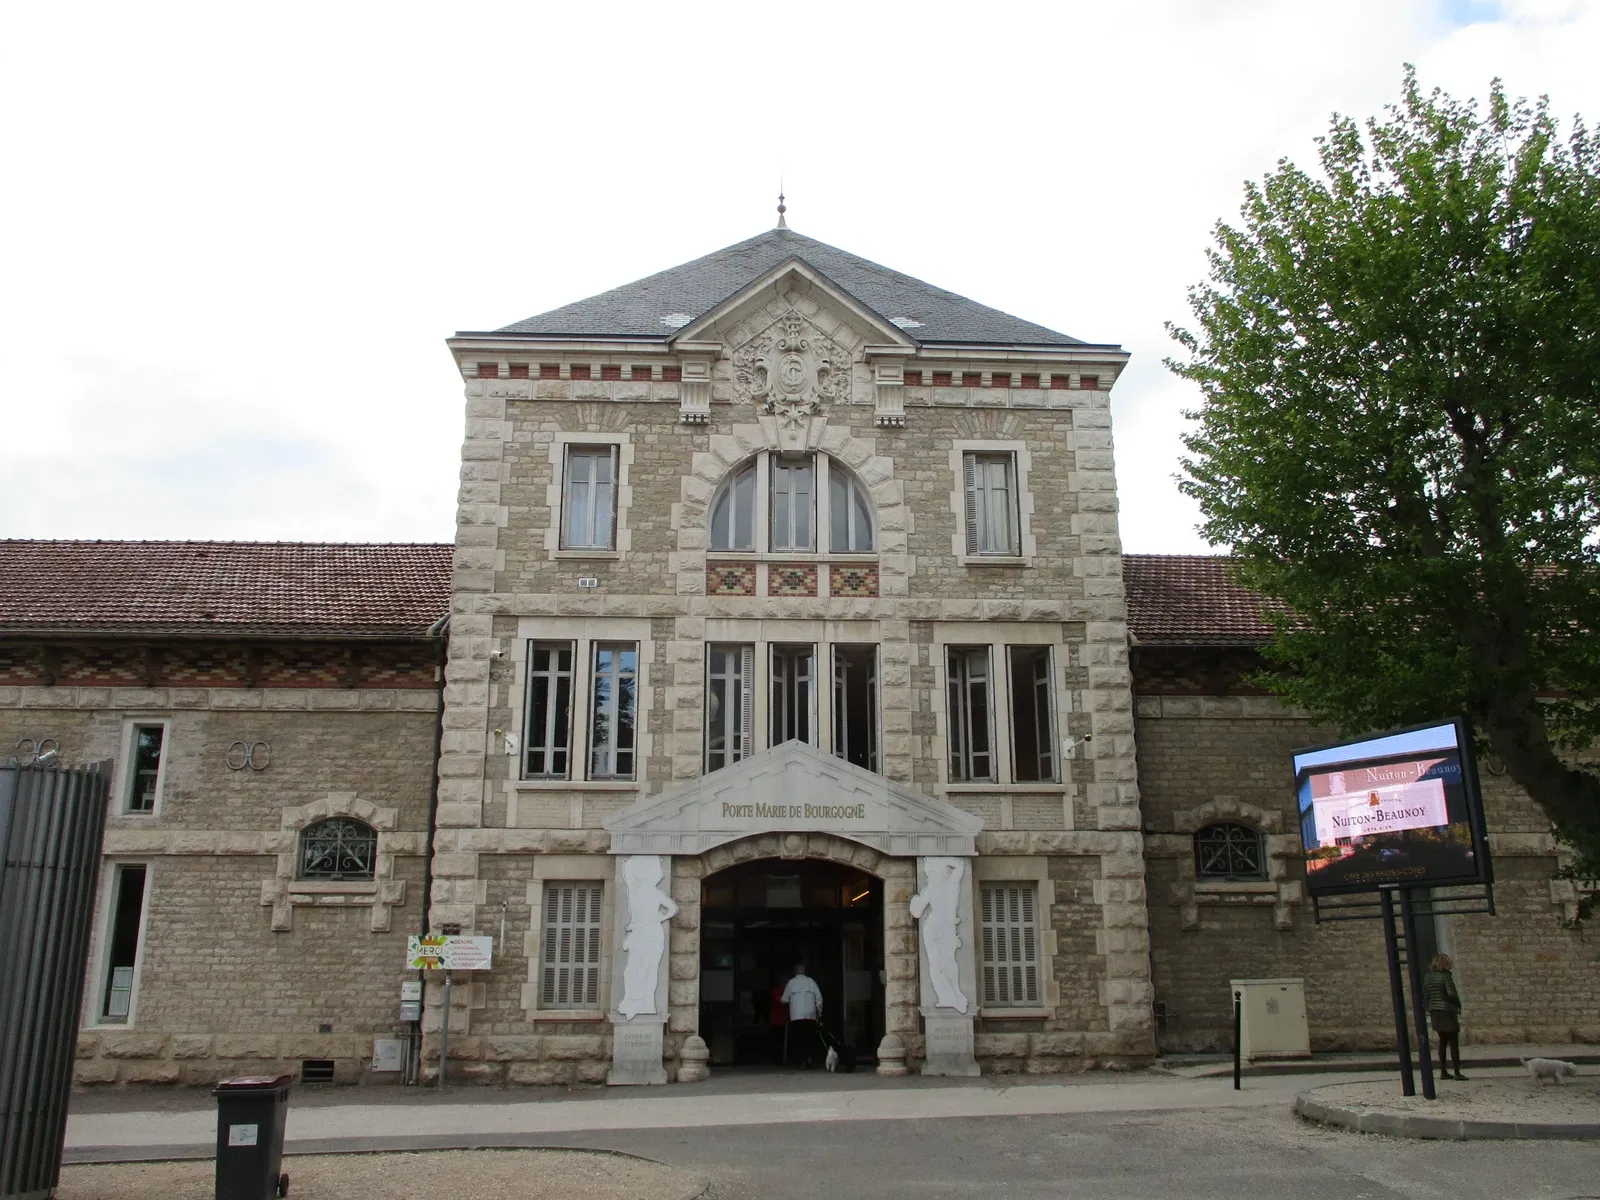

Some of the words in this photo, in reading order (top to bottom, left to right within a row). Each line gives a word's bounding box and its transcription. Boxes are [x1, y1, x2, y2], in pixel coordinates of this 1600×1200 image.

[722, 802, 754, 818] PORTE
[755, 803, 787, 818] MARIE
[789, 805, 802, 818] DE
[804, 803, 865, 819] BOURGOGNE
[416, 946, 443, 955] MERCI
